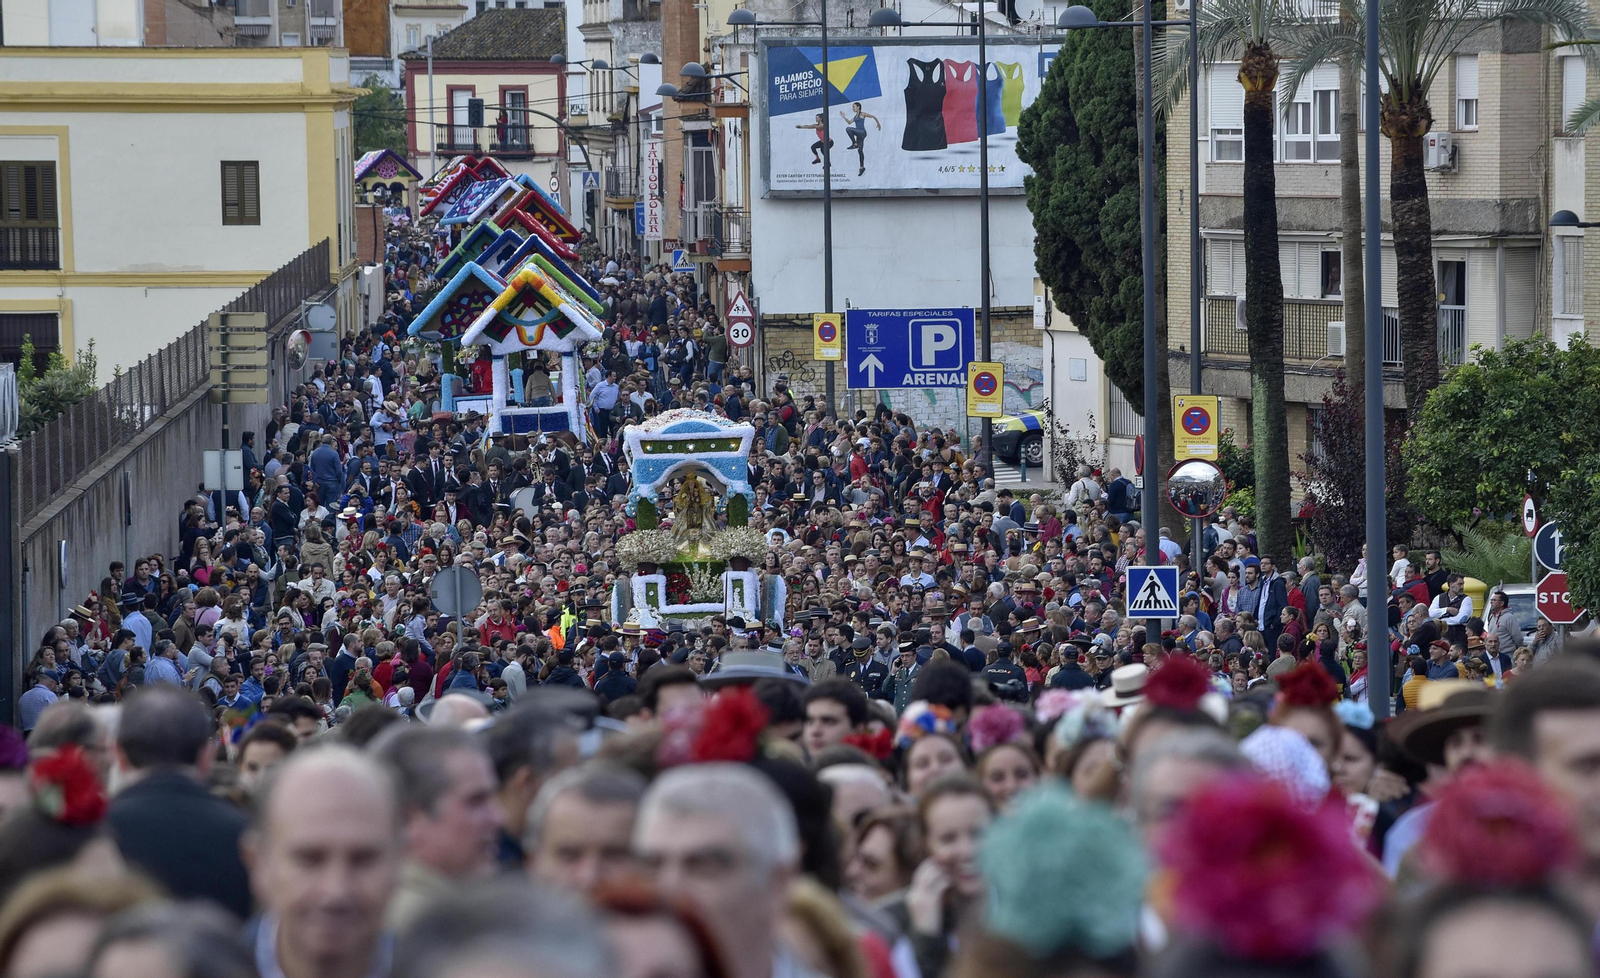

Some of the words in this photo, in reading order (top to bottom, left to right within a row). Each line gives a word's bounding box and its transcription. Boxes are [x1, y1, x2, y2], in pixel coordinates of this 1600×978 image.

[774, 70, 814, 86] BAJAMOS
[780, 84, 790, 94] EL
[792, 78, 822, 92] PRECIO
[780, 92, 797, 102] PARA
[798, 88, 824, 98] SIEMPR
[648, 142, 658, 190] TATTOO
[732, 328, 749, 338] 30
[921, 324, 956, 366] P
[902, 373, 968, 385] ARENAL
[1538, 592, 1572, 604] STO
